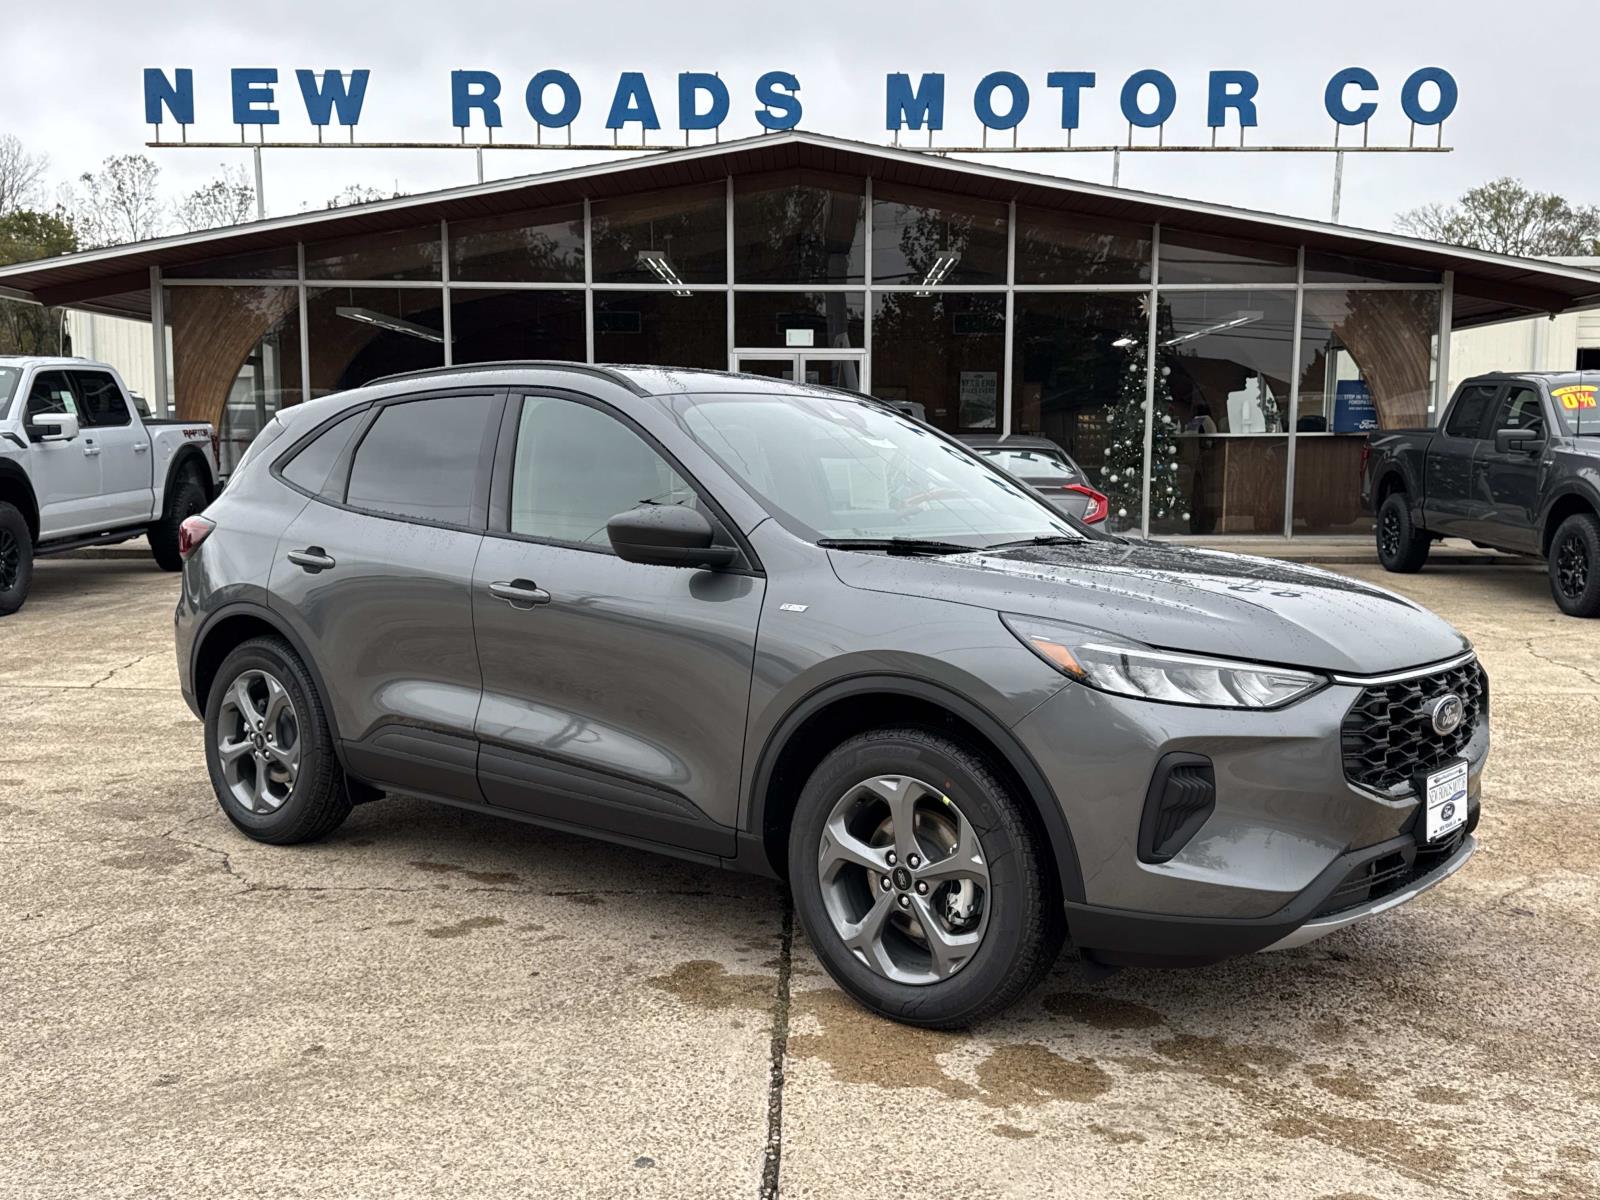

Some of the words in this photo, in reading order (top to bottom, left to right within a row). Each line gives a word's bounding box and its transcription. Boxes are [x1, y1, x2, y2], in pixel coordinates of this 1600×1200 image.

[144, 69, 369, 125] NEW
[452, 70, 801, 130] ROADS
[887, 69, 1258, 130] MOTOR
[1325, 67, 1457, 125] CO
[1561, 392, 1596, 409] 0%
